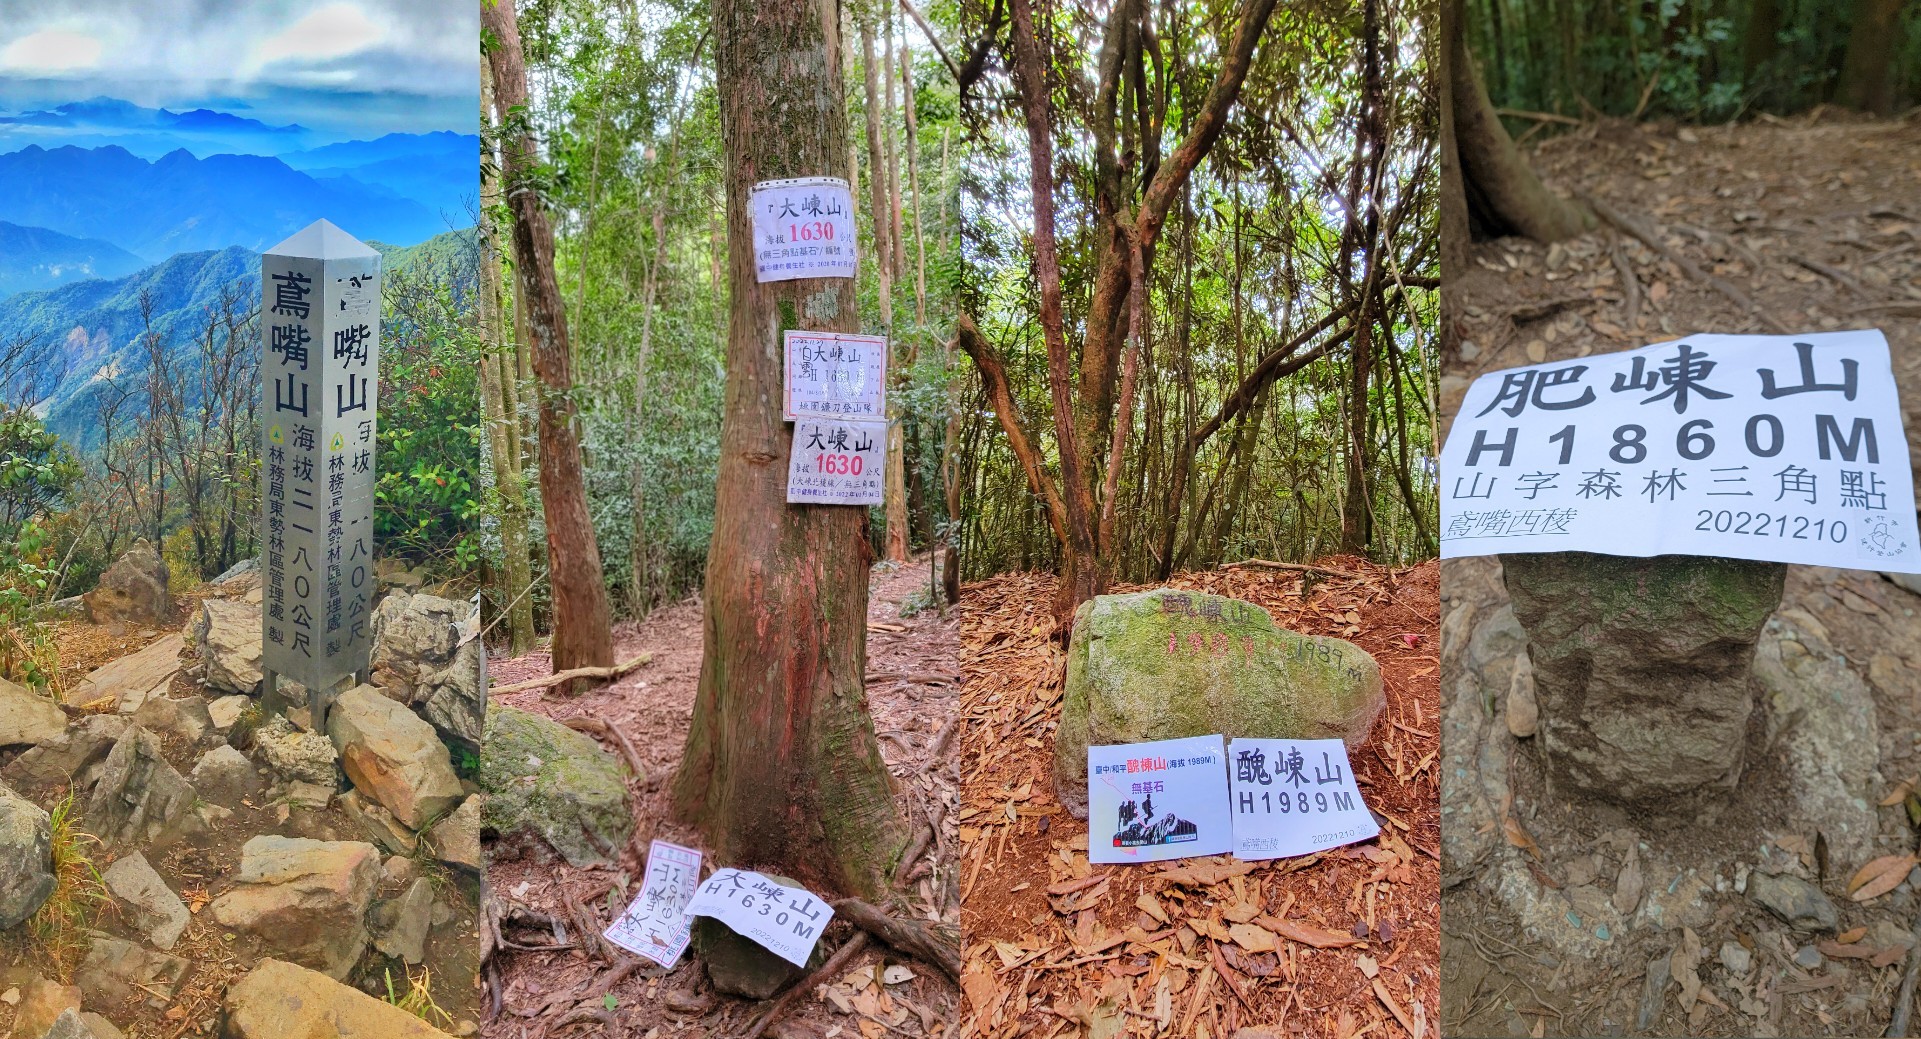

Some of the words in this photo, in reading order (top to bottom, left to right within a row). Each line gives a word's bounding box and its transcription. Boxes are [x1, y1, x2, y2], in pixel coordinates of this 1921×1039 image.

[789, 221, 834, 242] 1630
[271, 271, 312, 418] 鳶嘴山
[1475, 342, 1860, 418] 肥崠山
[816, 453, 863, 476] 1630
[866, 467, 880, 476] 公尺
[1452, 463, 1888, 512] 山字森林三角點
[268, 446, 285, 622] 林務局東勢林區管理處
[1441, 507, 1578, 538] 鳶嘴西稜
[1695, 508, 1848, 543] 20221210
[268, 626, 284, 647] 製
[326, 637, 342, 658] 製
[1296, 638, 1344, 672] 1989
[1347, 667, 1363, 681] M
[1237, 746, 1343, 789] 醜崠山
[1132, 780, 1164, 795] 無基石
[1312, 829, 1355, 844] 20221210
[713, 871, 821, 921] 大崠山
[750, 927, 790, 952] 20221210
